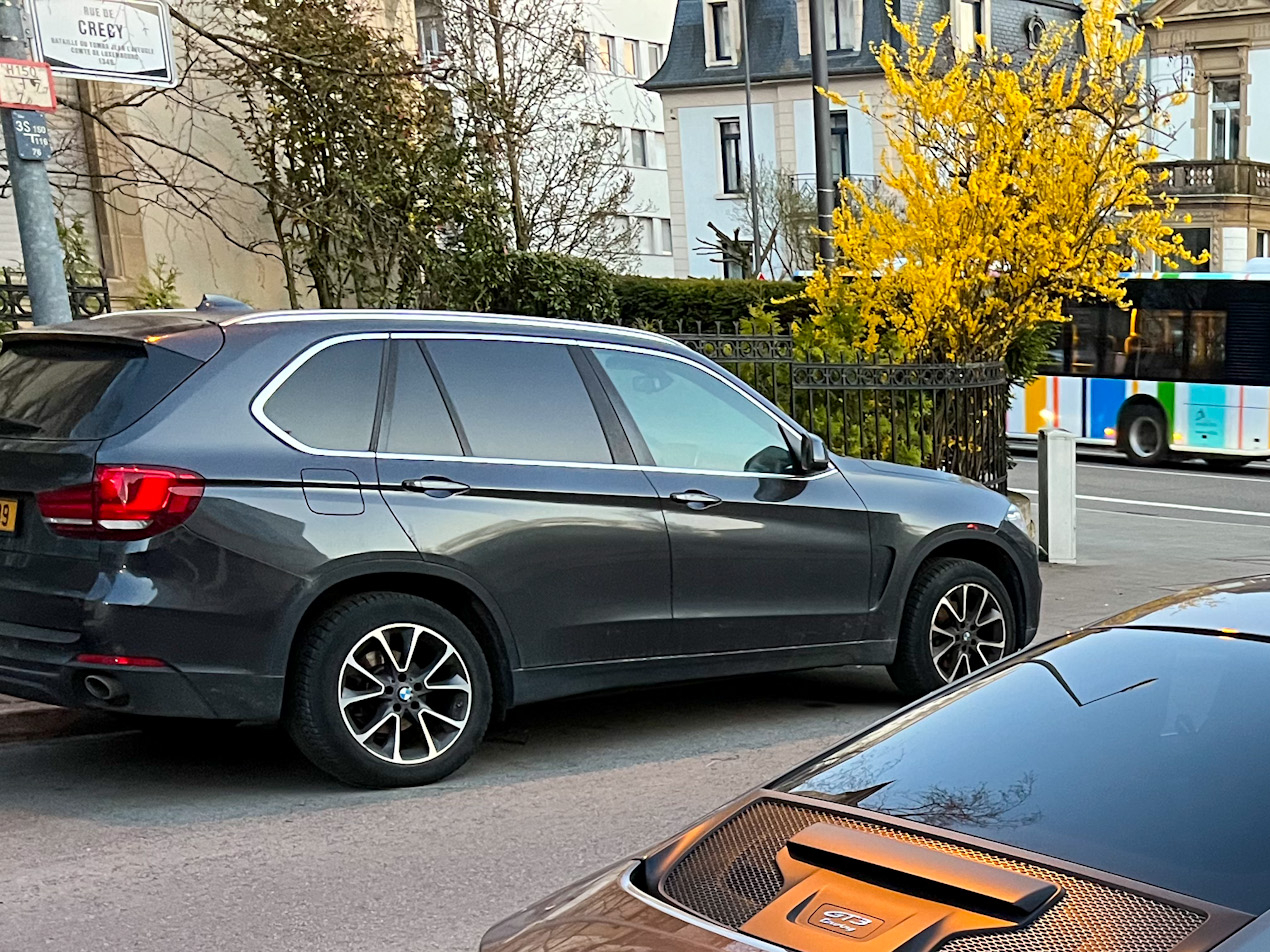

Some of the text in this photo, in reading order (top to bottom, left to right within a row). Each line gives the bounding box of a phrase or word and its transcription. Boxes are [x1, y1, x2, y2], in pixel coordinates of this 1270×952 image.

[83, 6, 114, 19] RUE DE
[823, 910, 873, 926] GT3
